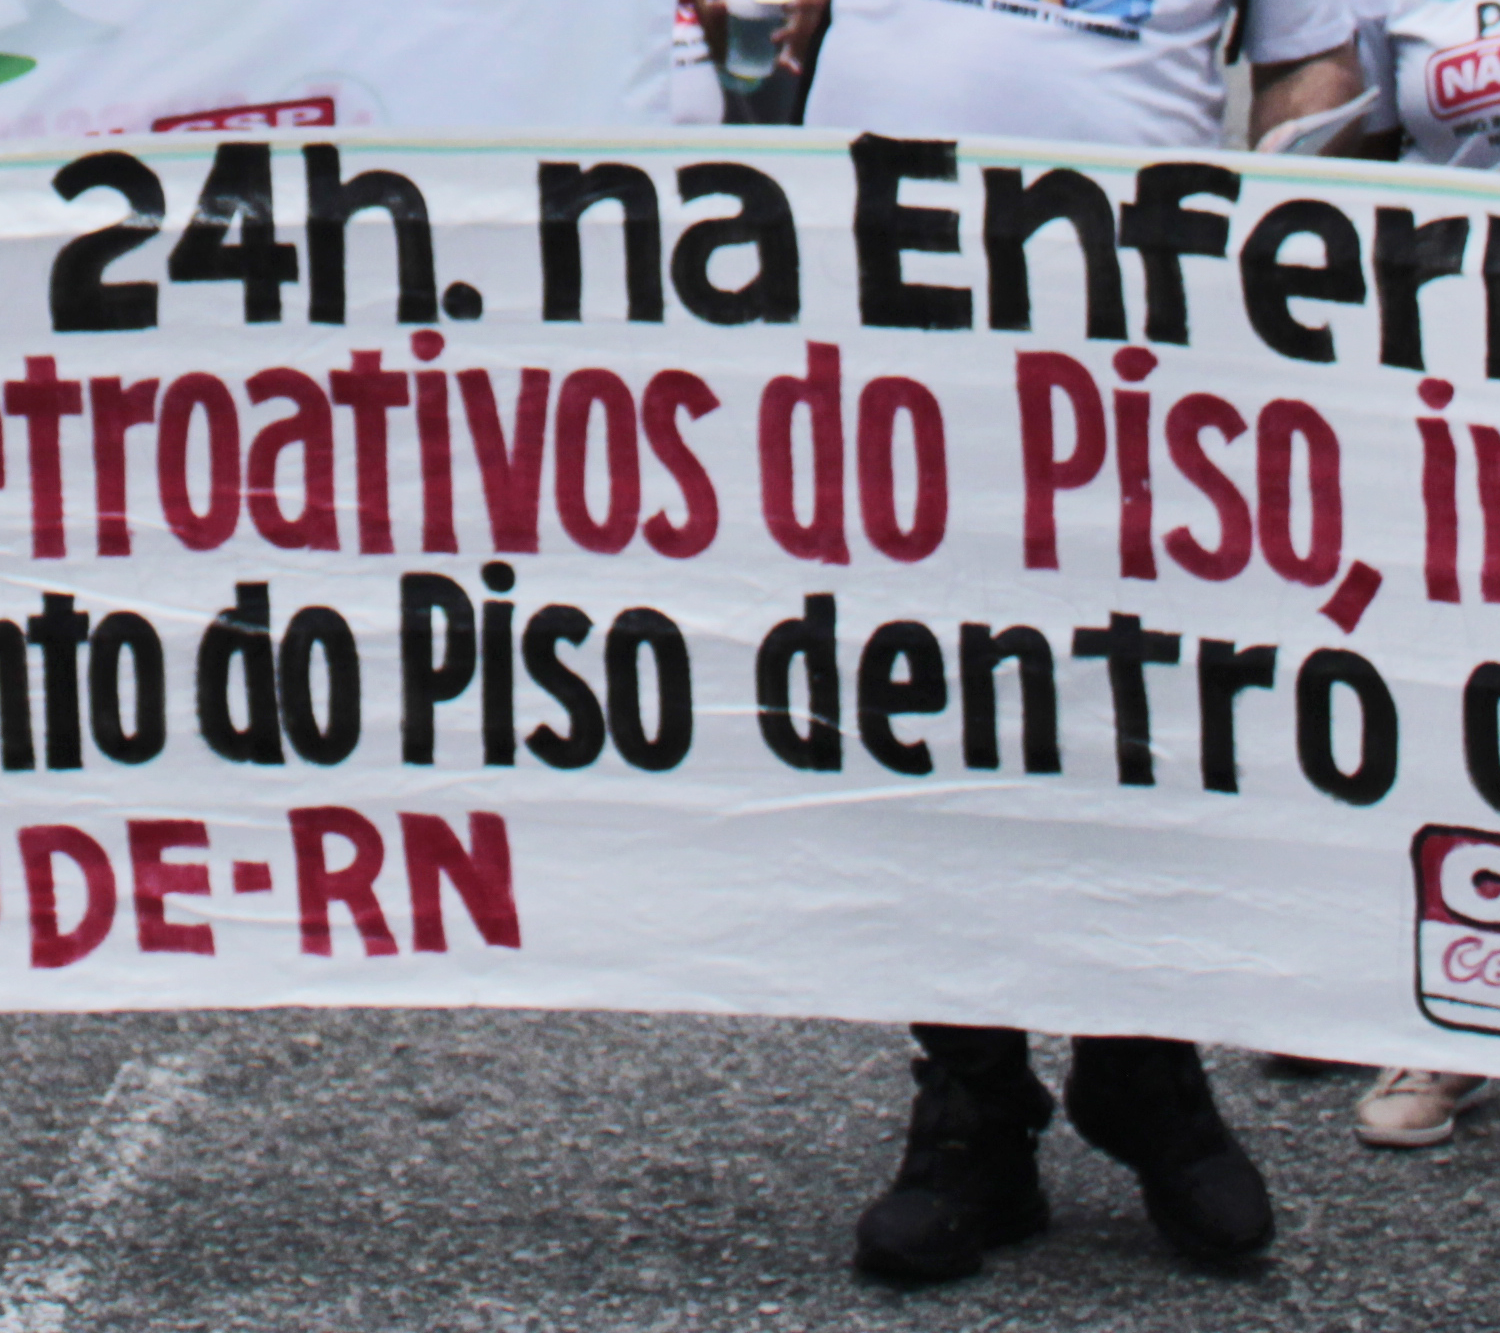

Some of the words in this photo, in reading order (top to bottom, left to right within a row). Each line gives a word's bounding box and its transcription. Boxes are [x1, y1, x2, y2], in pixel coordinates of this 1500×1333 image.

[49, 143, 484, 333] 24h.
[537, 161, 801, 326] na
[758, 340, 948, 566] do
[1016, 345, 1383, 634] Piso,
[197, 581, 361, 767] do
[398, 560, 693, 773] Piso
[754, 591, 1400, 805] dentro
